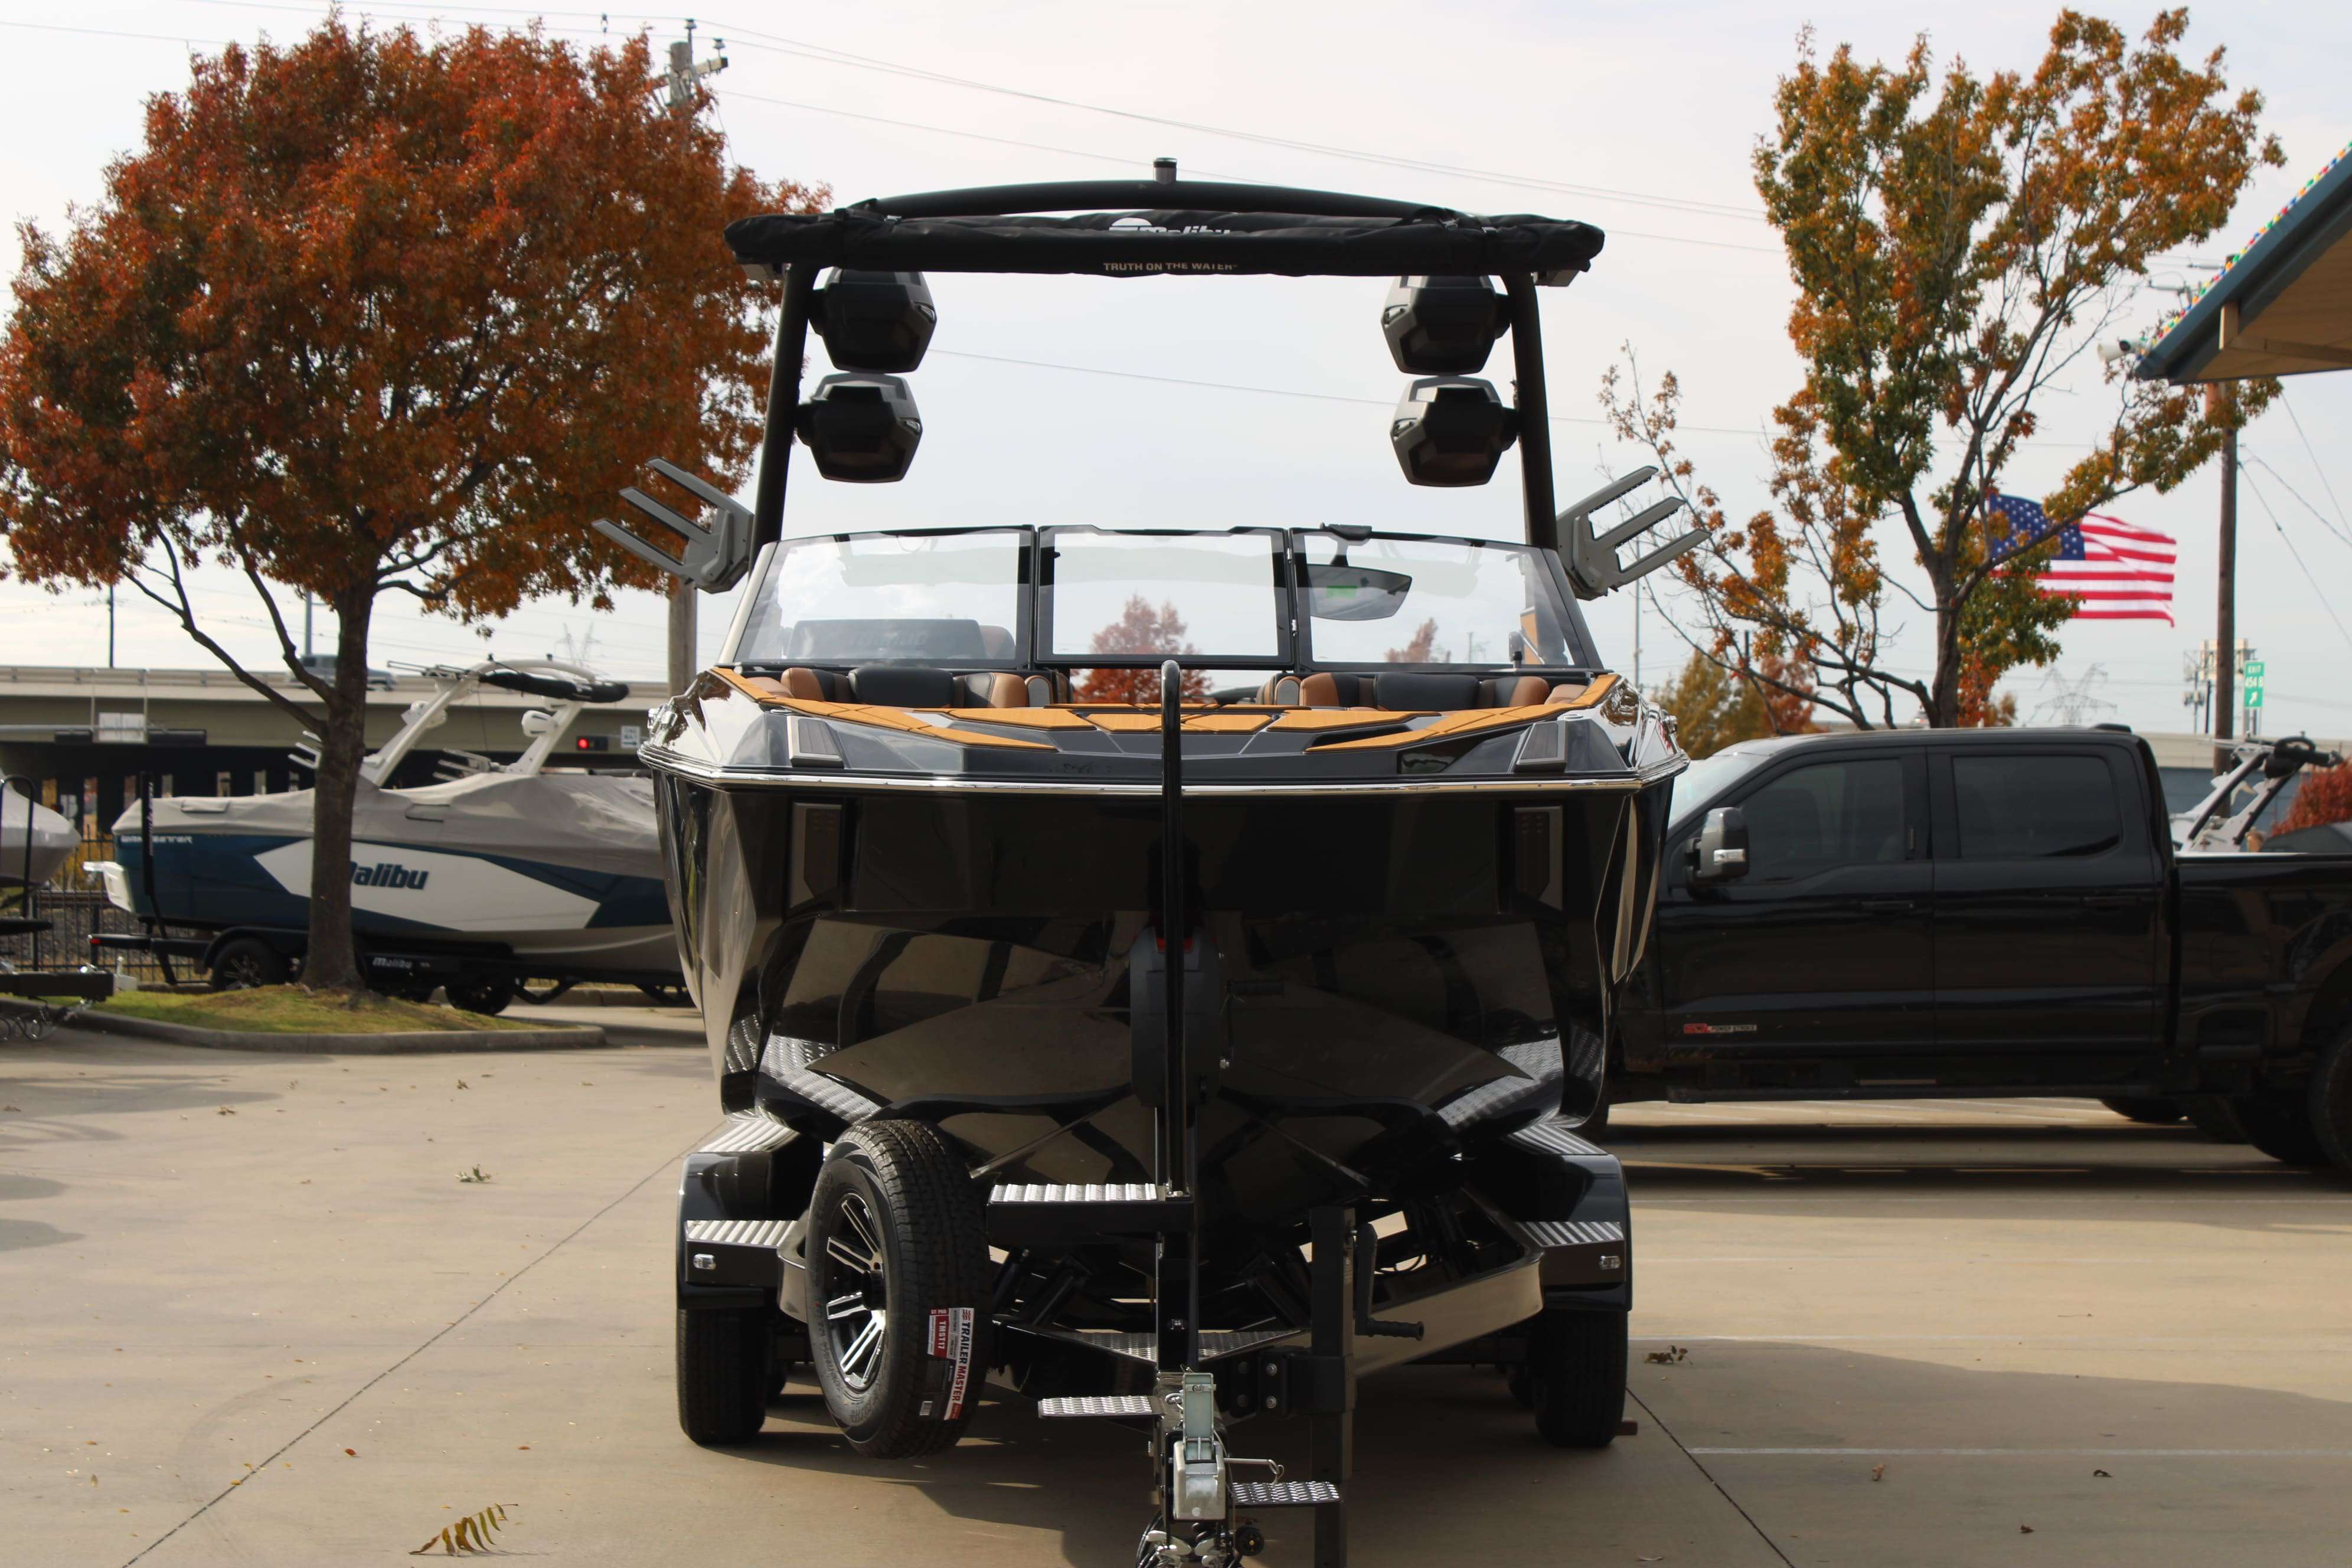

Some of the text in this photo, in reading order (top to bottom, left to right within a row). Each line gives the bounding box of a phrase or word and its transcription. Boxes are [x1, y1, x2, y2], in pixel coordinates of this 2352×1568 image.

[1103, 262, 1143, 271] TRUTH
[1146, 263, 1162, 271] ON
[2248, 665, 2261, 674] EXIT
[959, 1322, 970, 1364] TRAILER
[952, 1366, 967, 1402] MASTER
